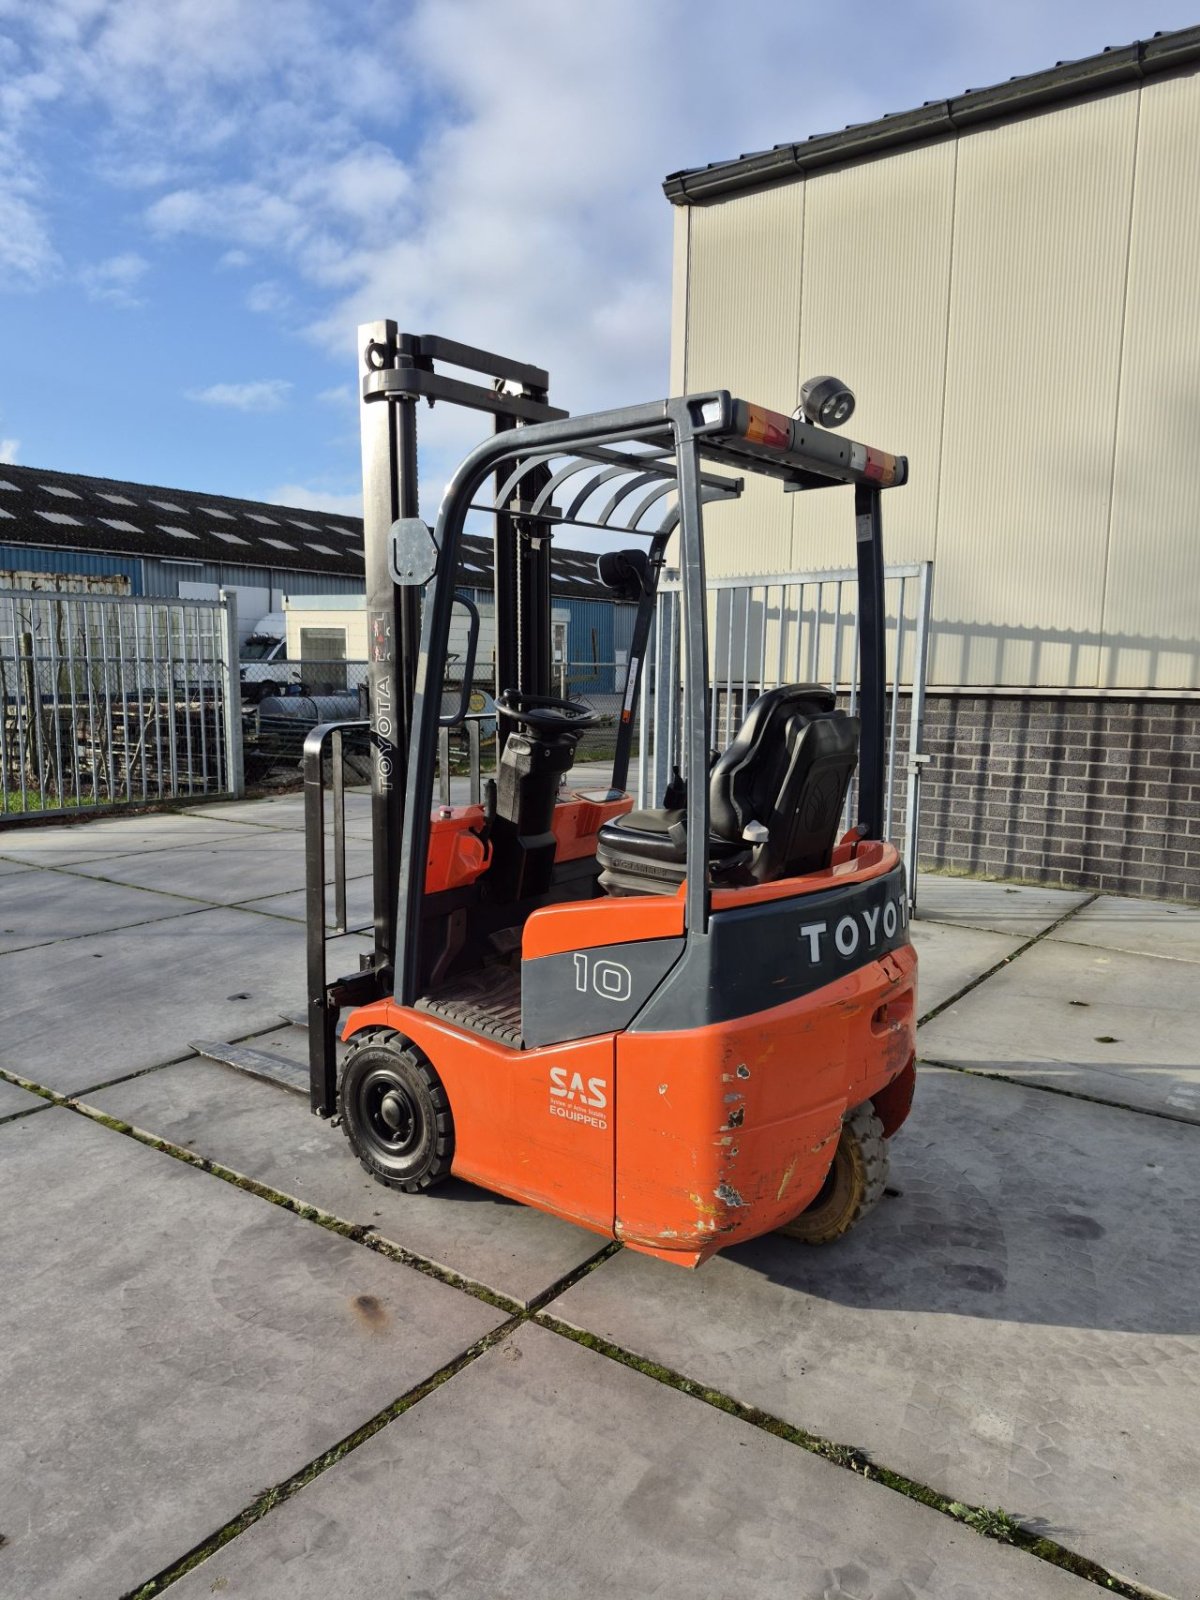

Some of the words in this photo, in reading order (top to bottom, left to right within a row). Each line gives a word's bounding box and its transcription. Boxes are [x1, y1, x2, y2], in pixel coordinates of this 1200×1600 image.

[376, 675, 393, 795] TOYOTA
[573, 952, 632, 1002] 10
[549, 1067, 607, 1109] SAS
[549, 1104, 608, 1130] EQUIPPED
